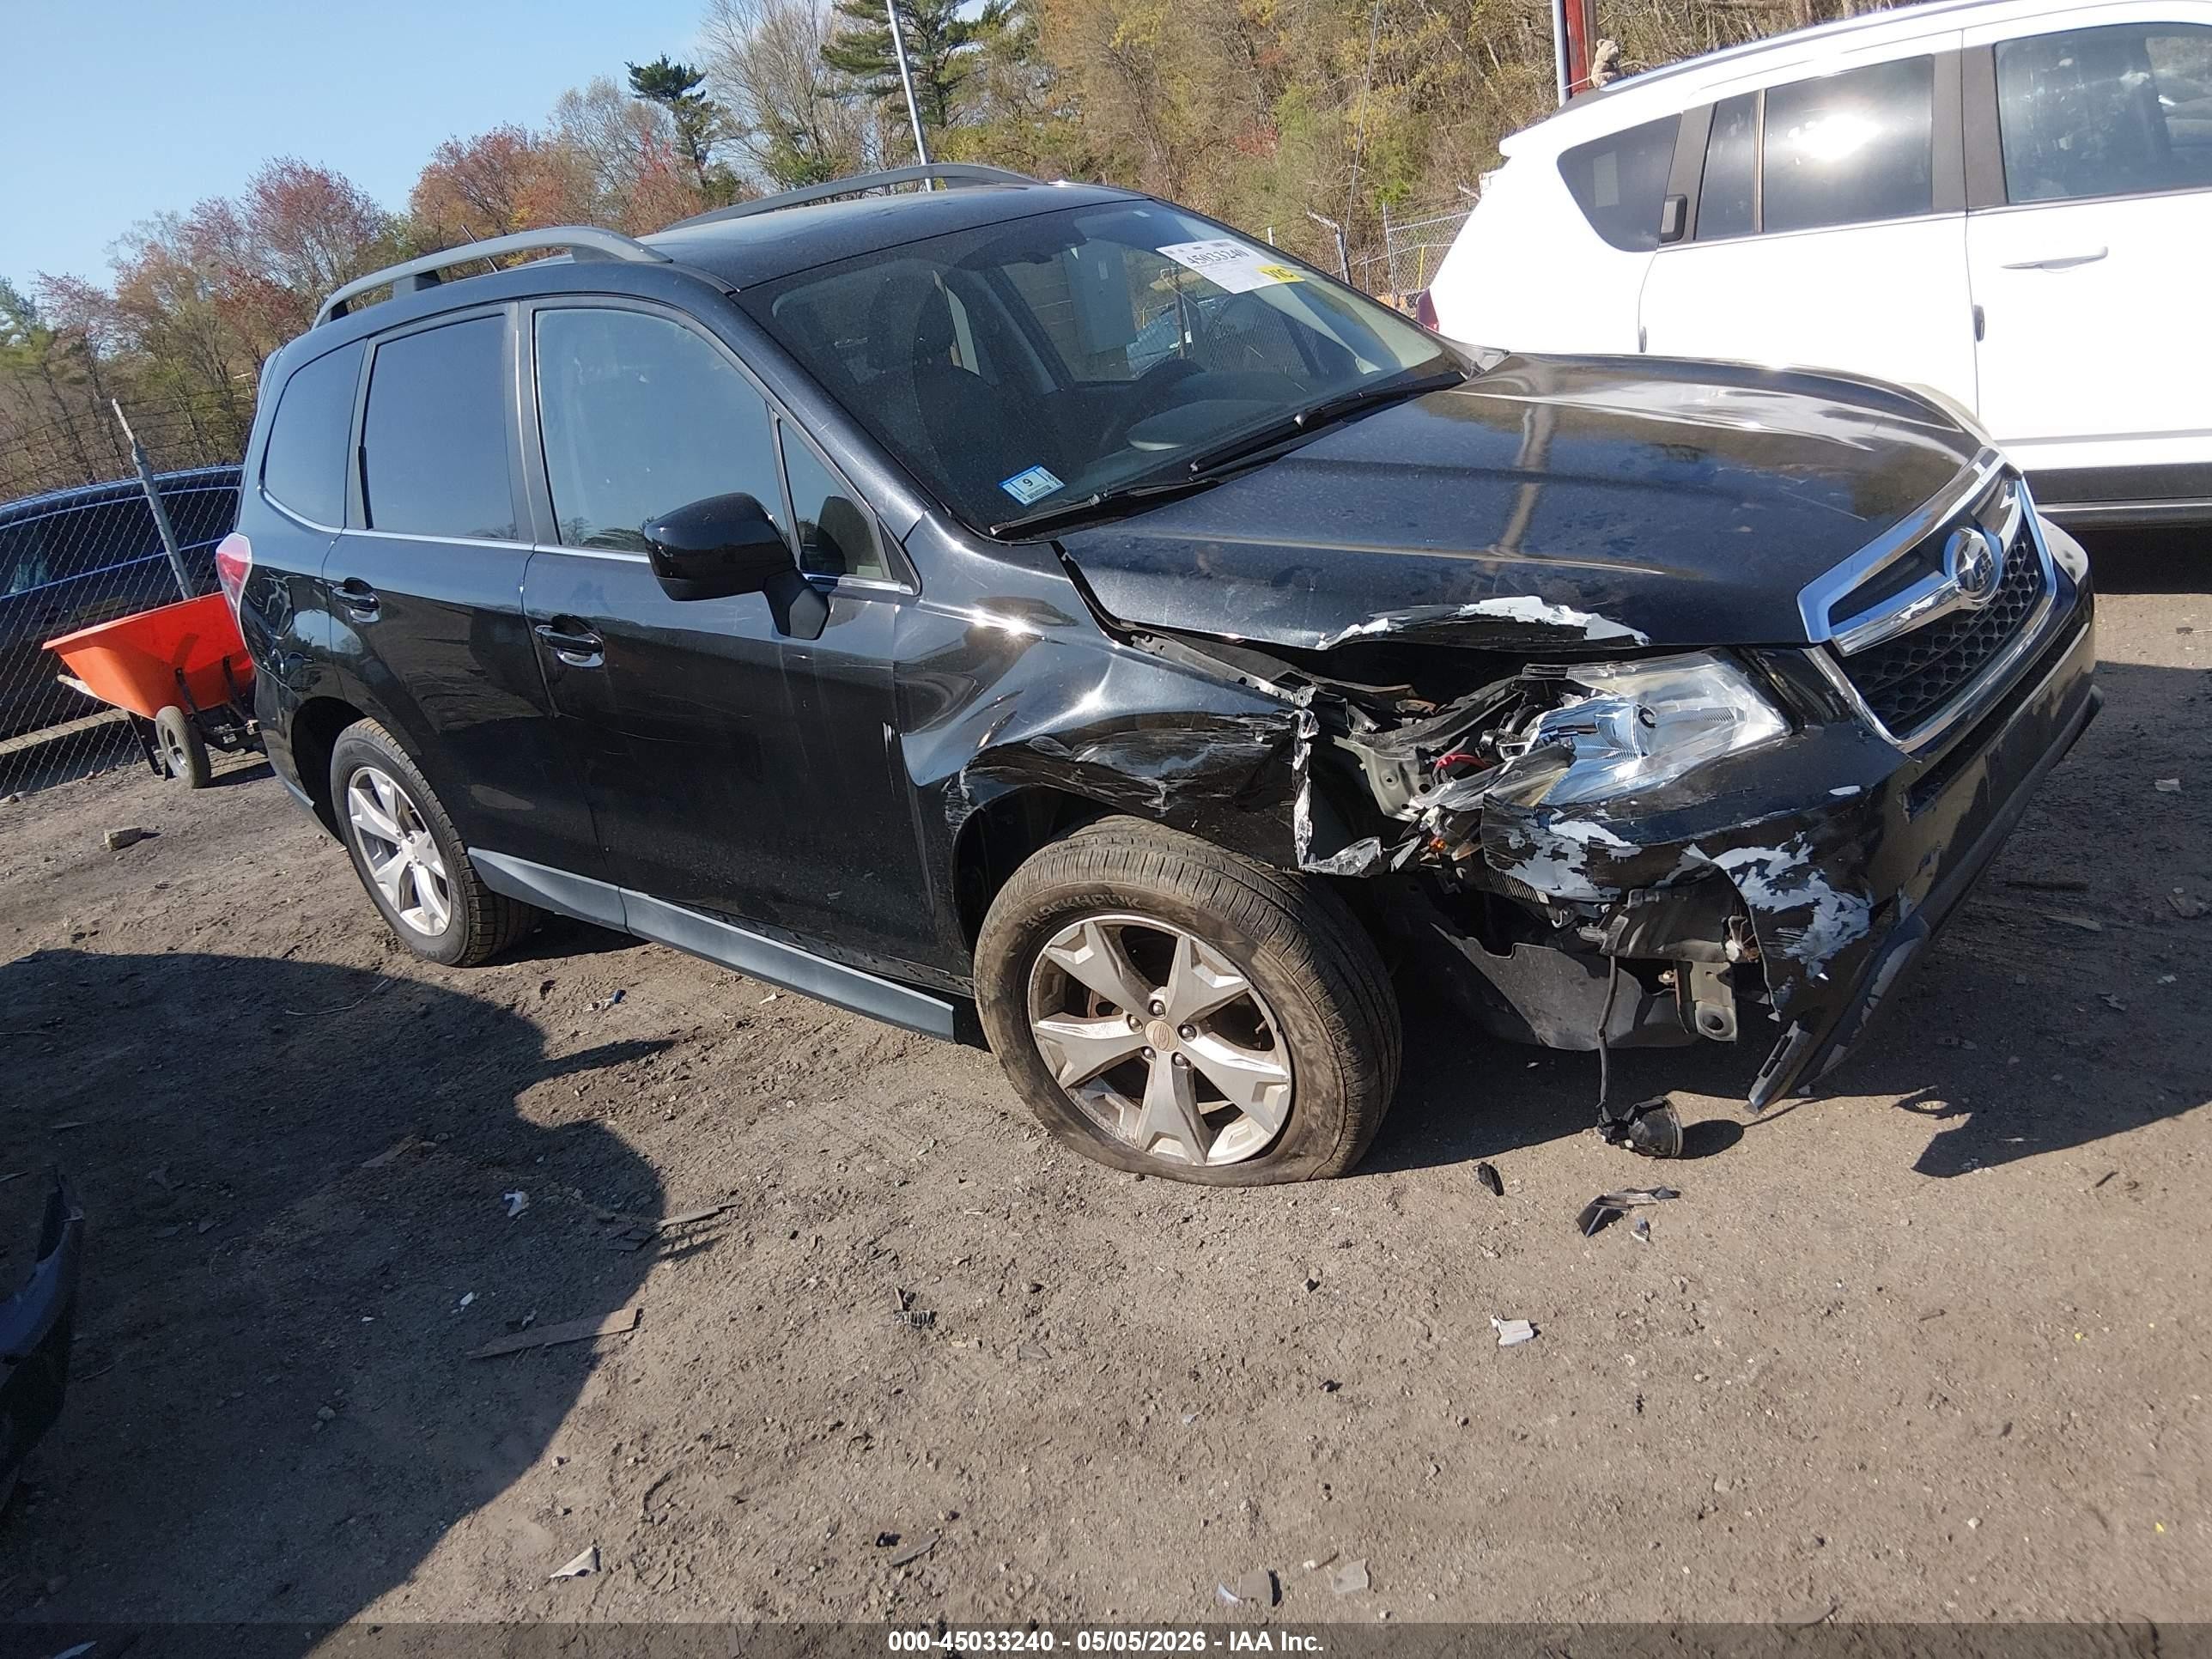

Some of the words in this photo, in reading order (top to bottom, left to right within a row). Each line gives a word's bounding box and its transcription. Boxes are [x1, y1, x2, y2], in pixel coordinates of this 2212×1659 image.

[1186, 249, 1249, 264] 45033240
[1261, 269, 1294, 280] VIC
[1023, 478, 1034, 487] 9
